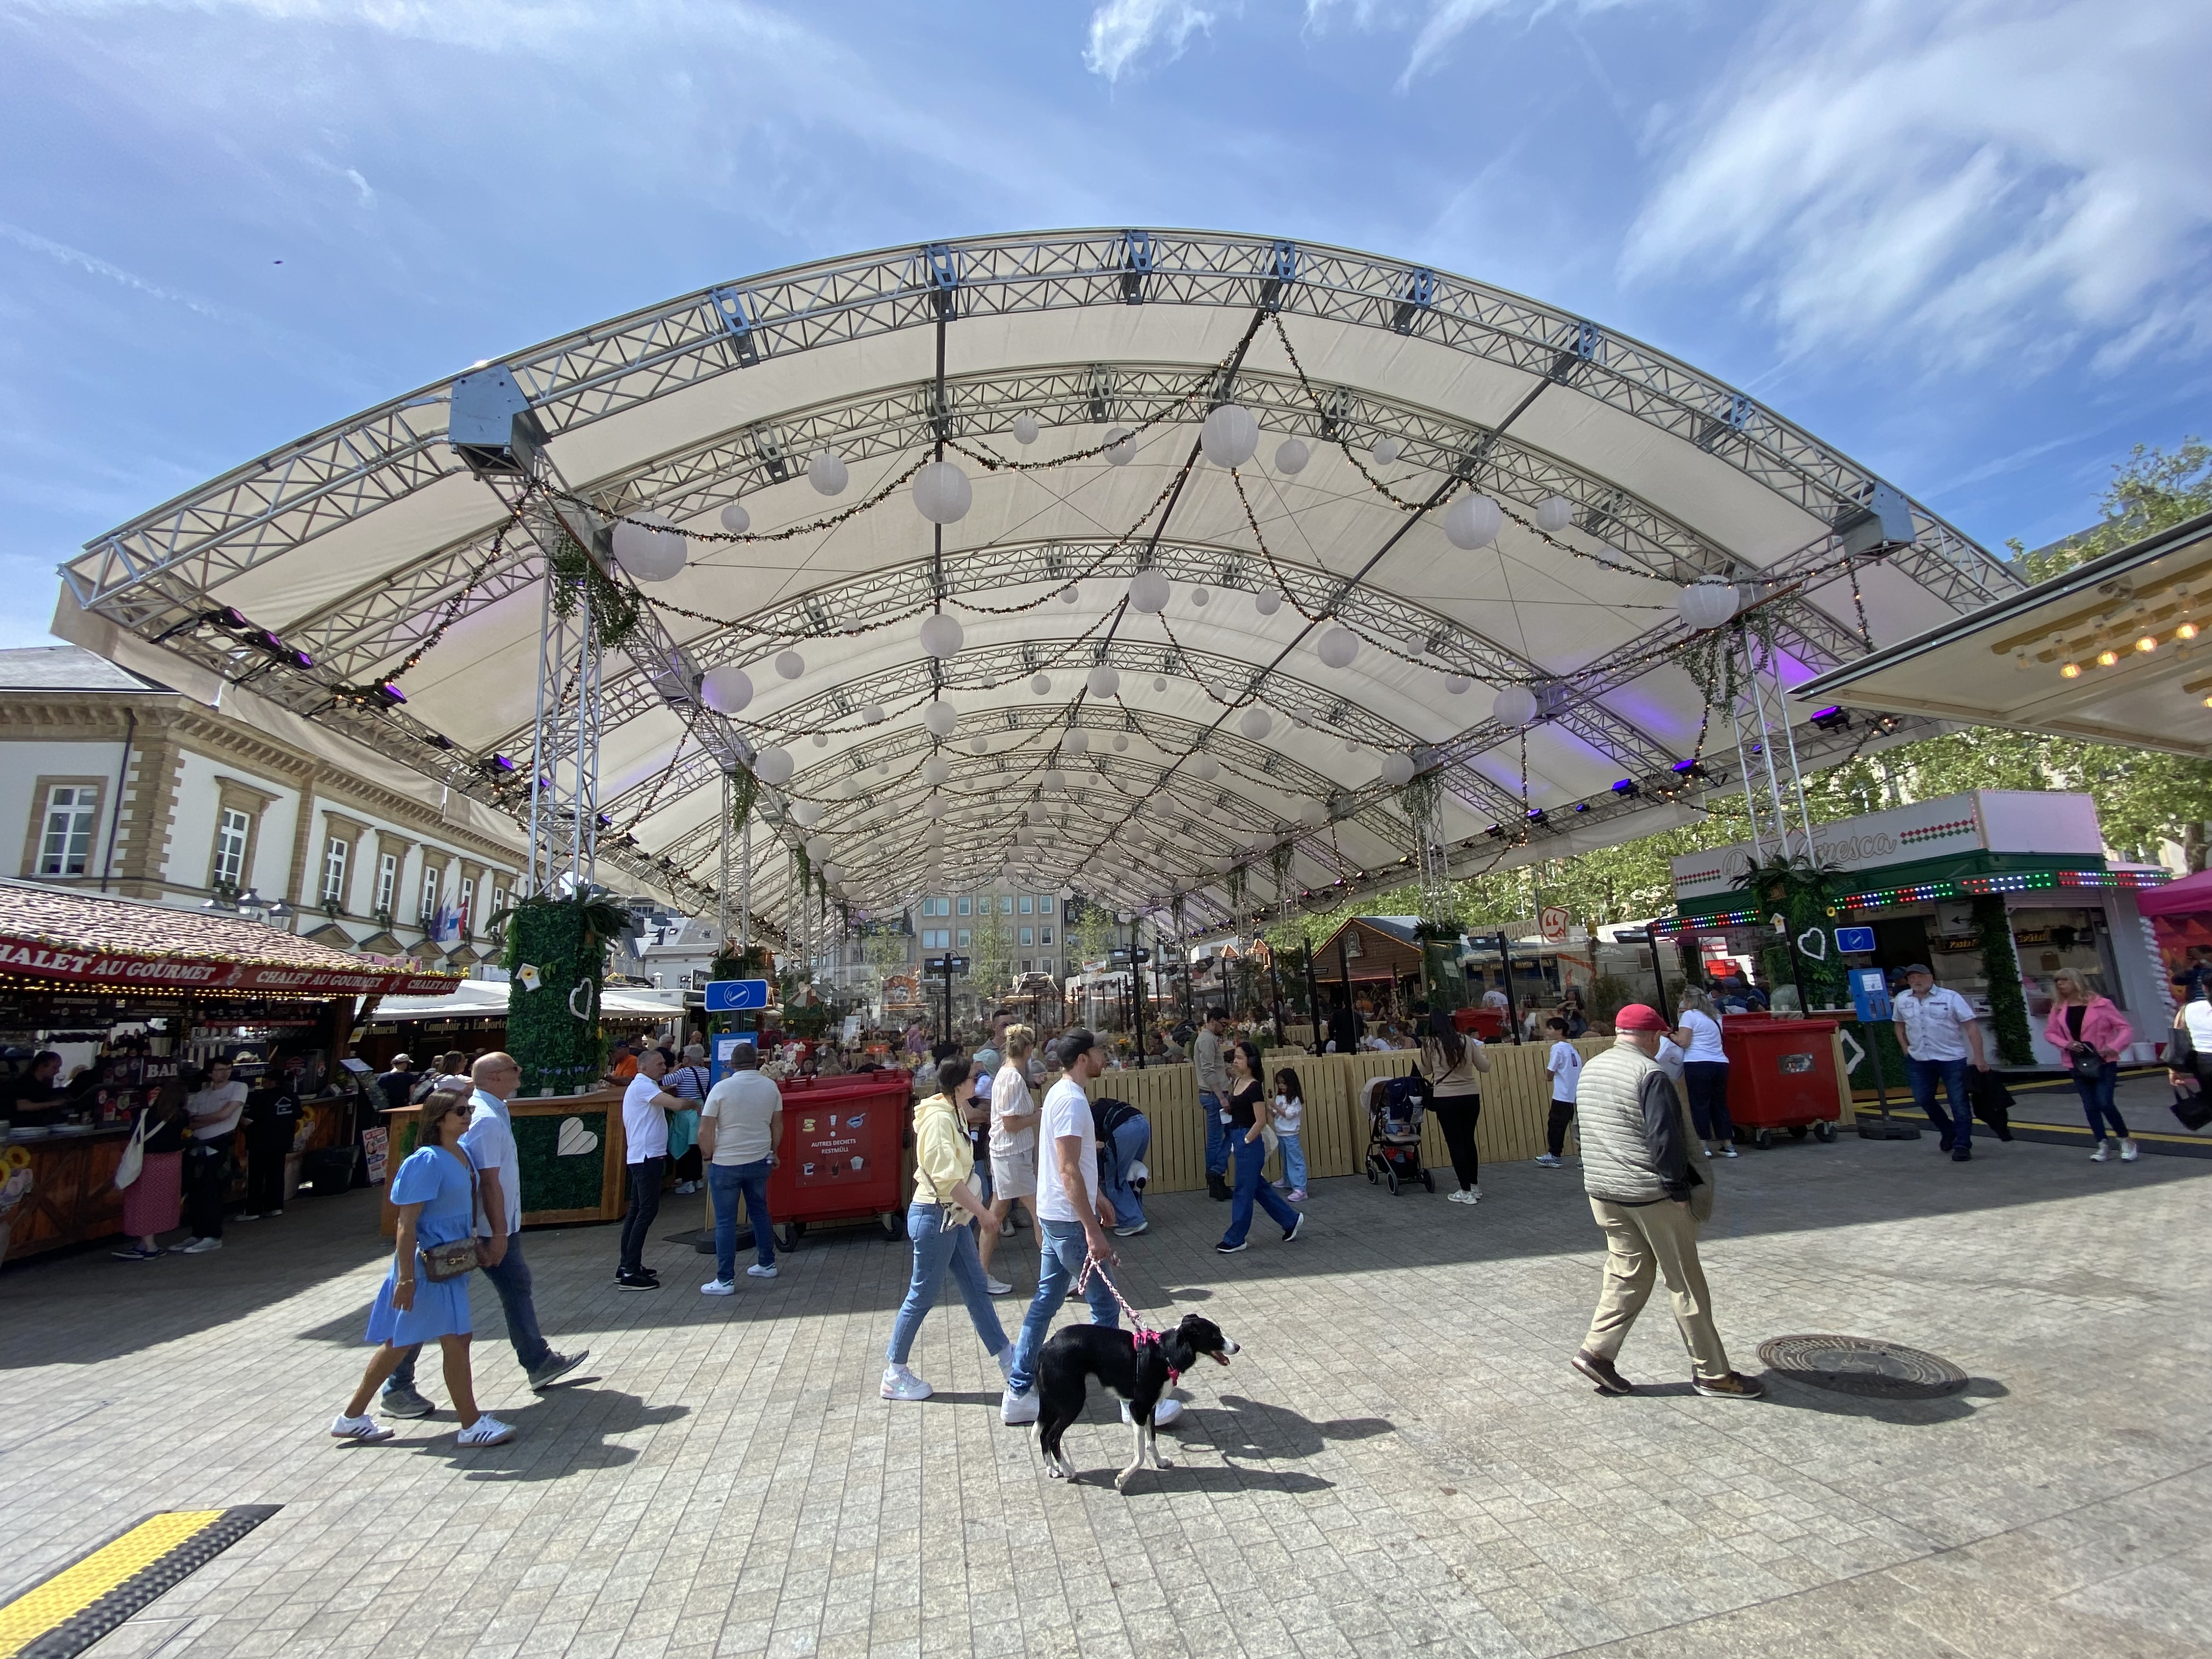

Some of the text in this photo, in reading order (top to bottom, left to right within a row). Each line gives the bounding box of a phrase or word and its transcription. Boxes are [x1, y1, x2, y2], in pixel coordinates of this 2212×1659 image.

[91, 960, 127, 976] AU
[127, 962, 216, 980] GOURMET
[256, 970, 384, 988] CHALET AU GOURMET
[407, 979, 443, 990] CHALET
[439, 981, 455, 991] AU
[365, 1022, 397, 1035] Froment
[424, 1019, 506, 1034] Comptoir à Emporte
